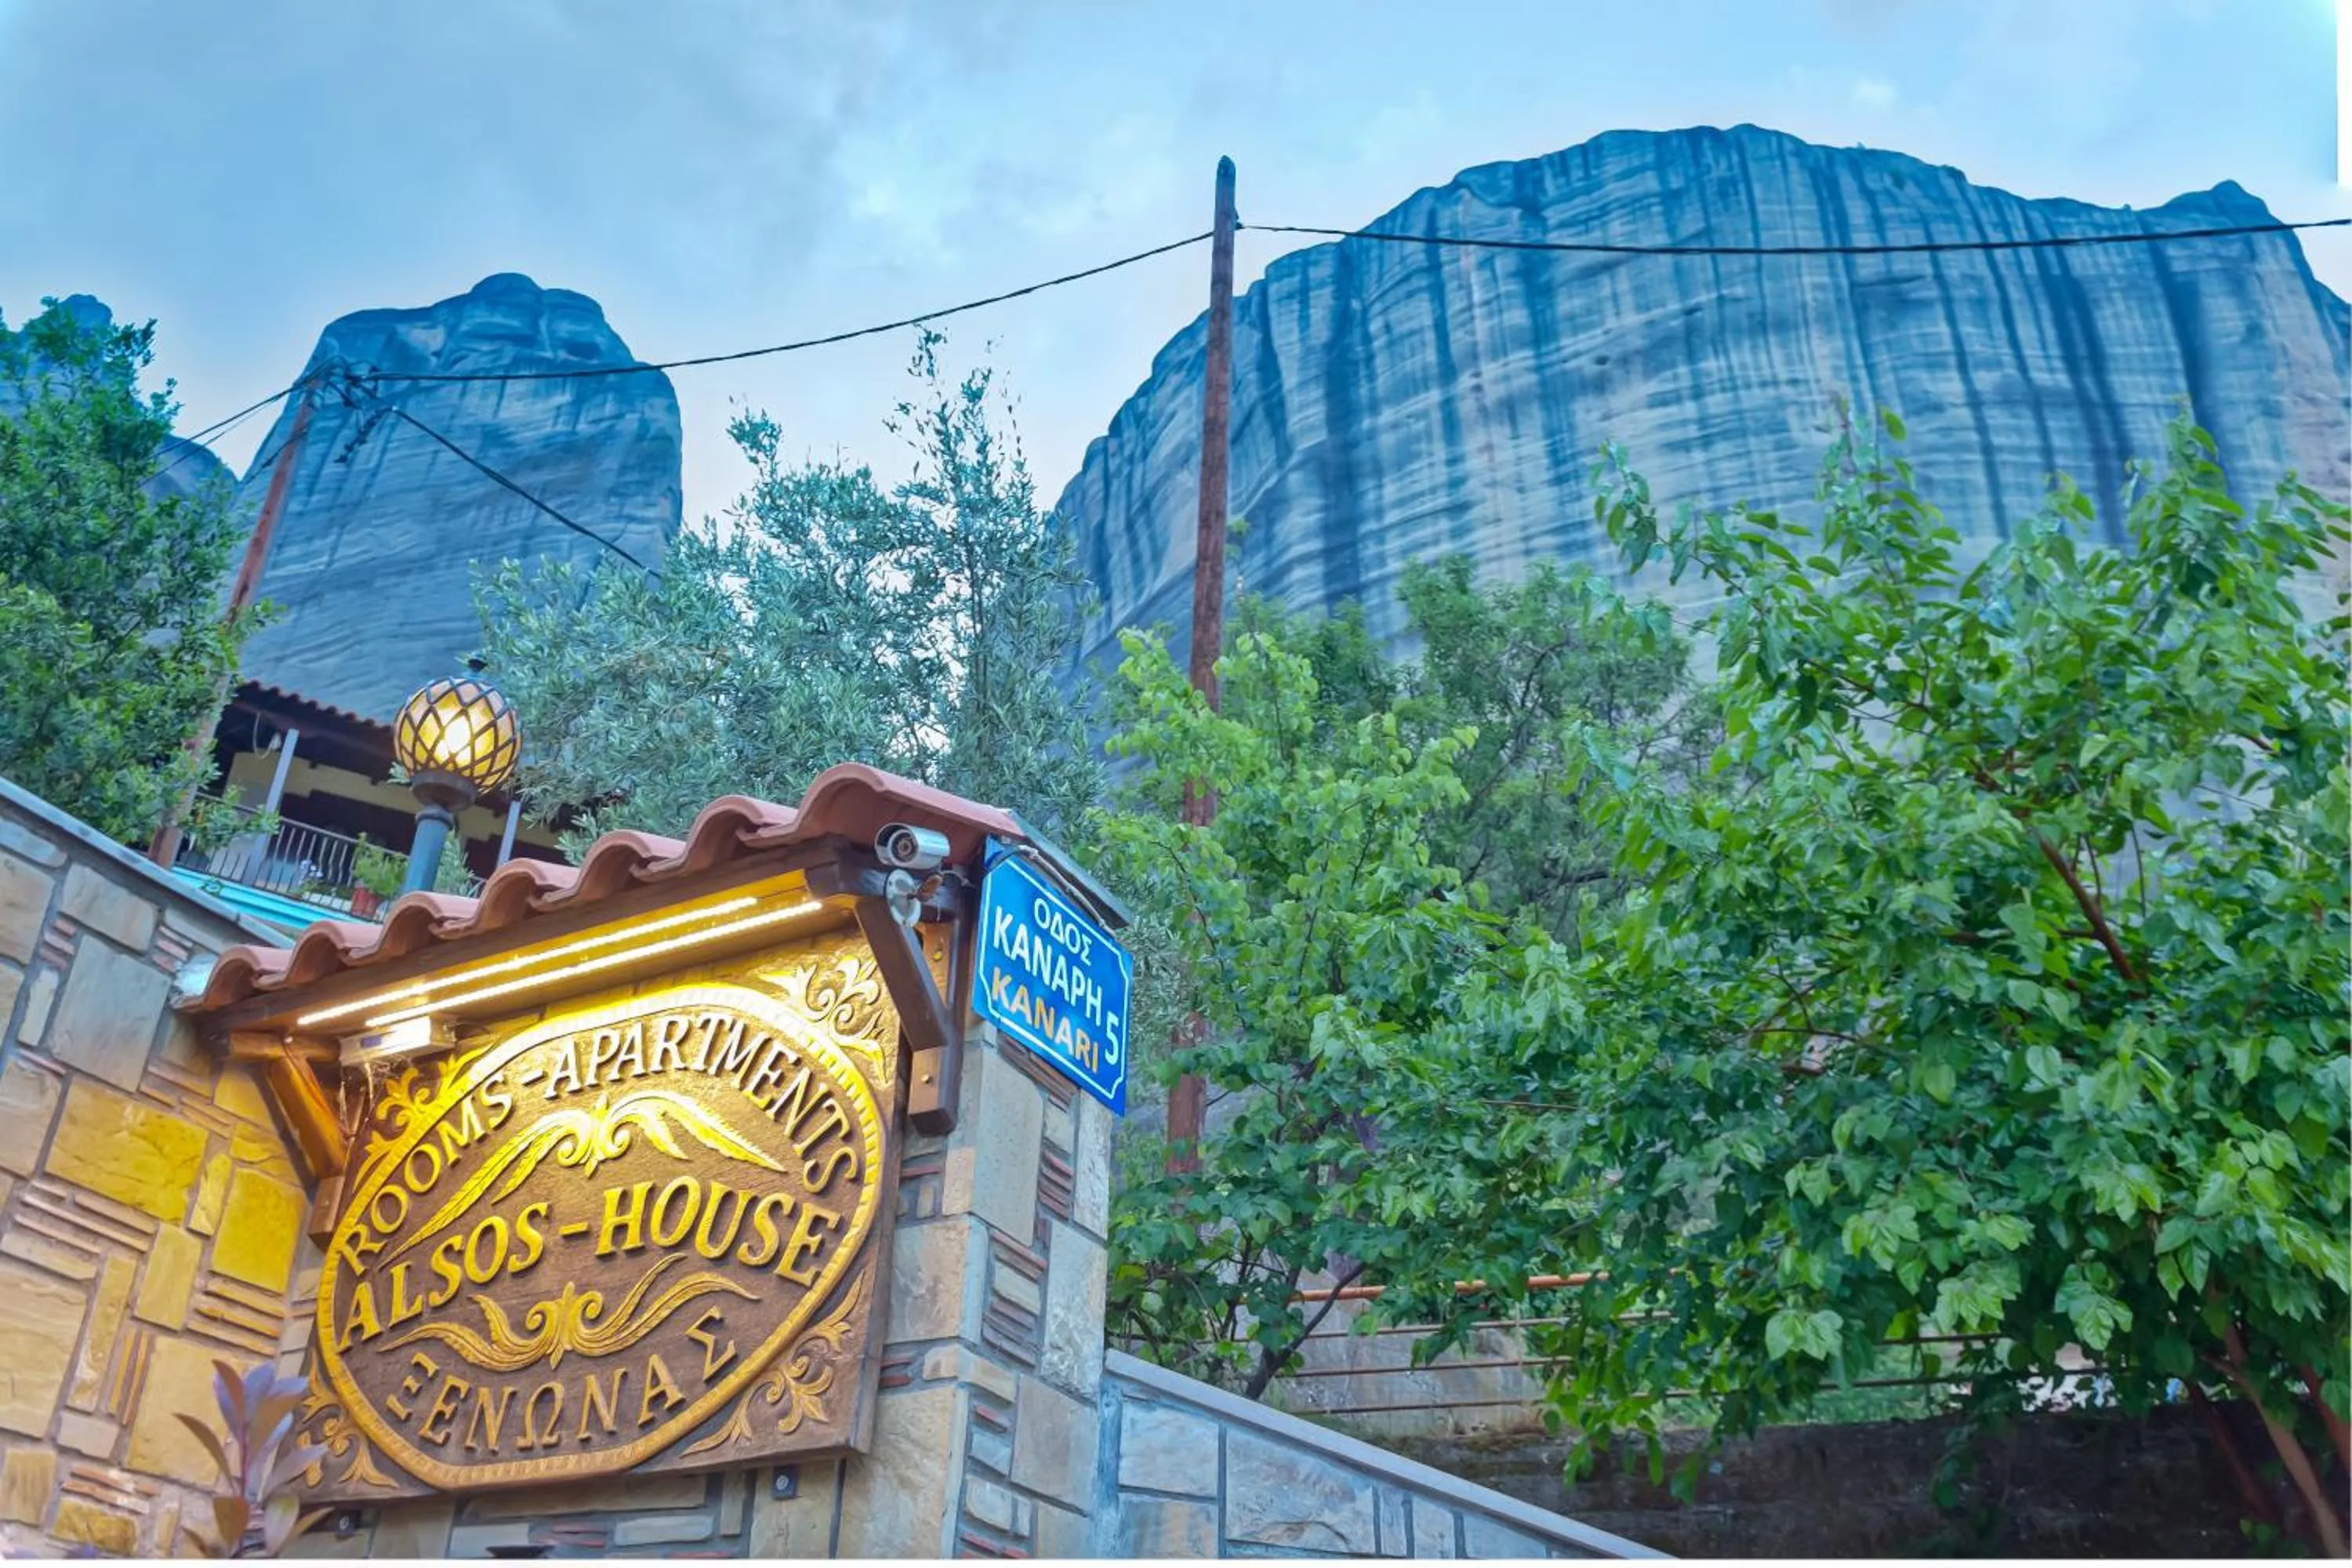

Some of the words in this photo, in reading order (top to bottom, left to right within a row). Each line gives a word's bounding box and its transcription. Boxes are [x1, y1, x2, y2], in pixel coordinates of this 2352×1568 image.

[993, 905, 1102, 1026] ΚΑΝΑΡΗ
[1034, 898, 1092, 966] ΟΔΟΣ
[992, 967, 1099, 1073] KANARI
[1105, 1011, 1119, 1065] 5
[385, 1306, 737, 1453] ΞΕΝΩΝΑΣ
